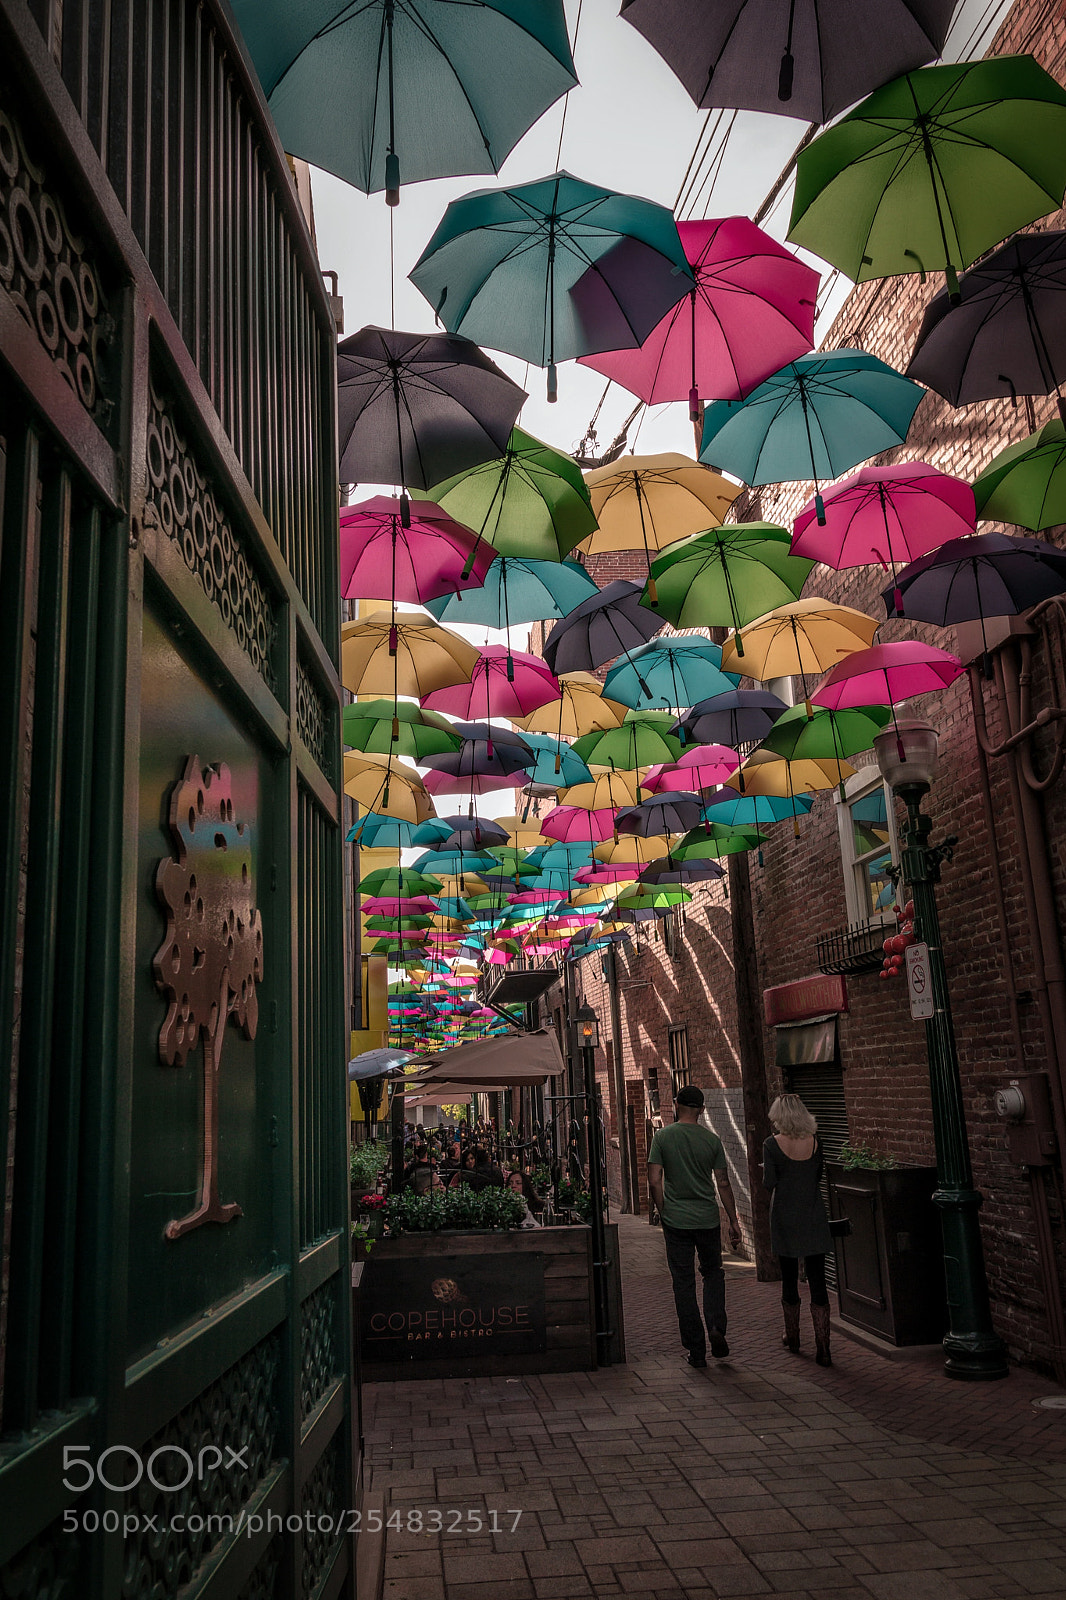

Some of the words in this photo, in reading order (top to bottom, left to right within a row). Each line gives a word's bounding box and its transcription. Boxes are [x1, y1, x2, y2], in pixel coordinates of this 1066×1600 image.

[370, 1305, 529, 1332] COPEHOUSE
[407, 1331, 431, 1341] BAR
[437, 1331, 444, 1339] &
[450, 1328, 493, 1339] BISTRO
